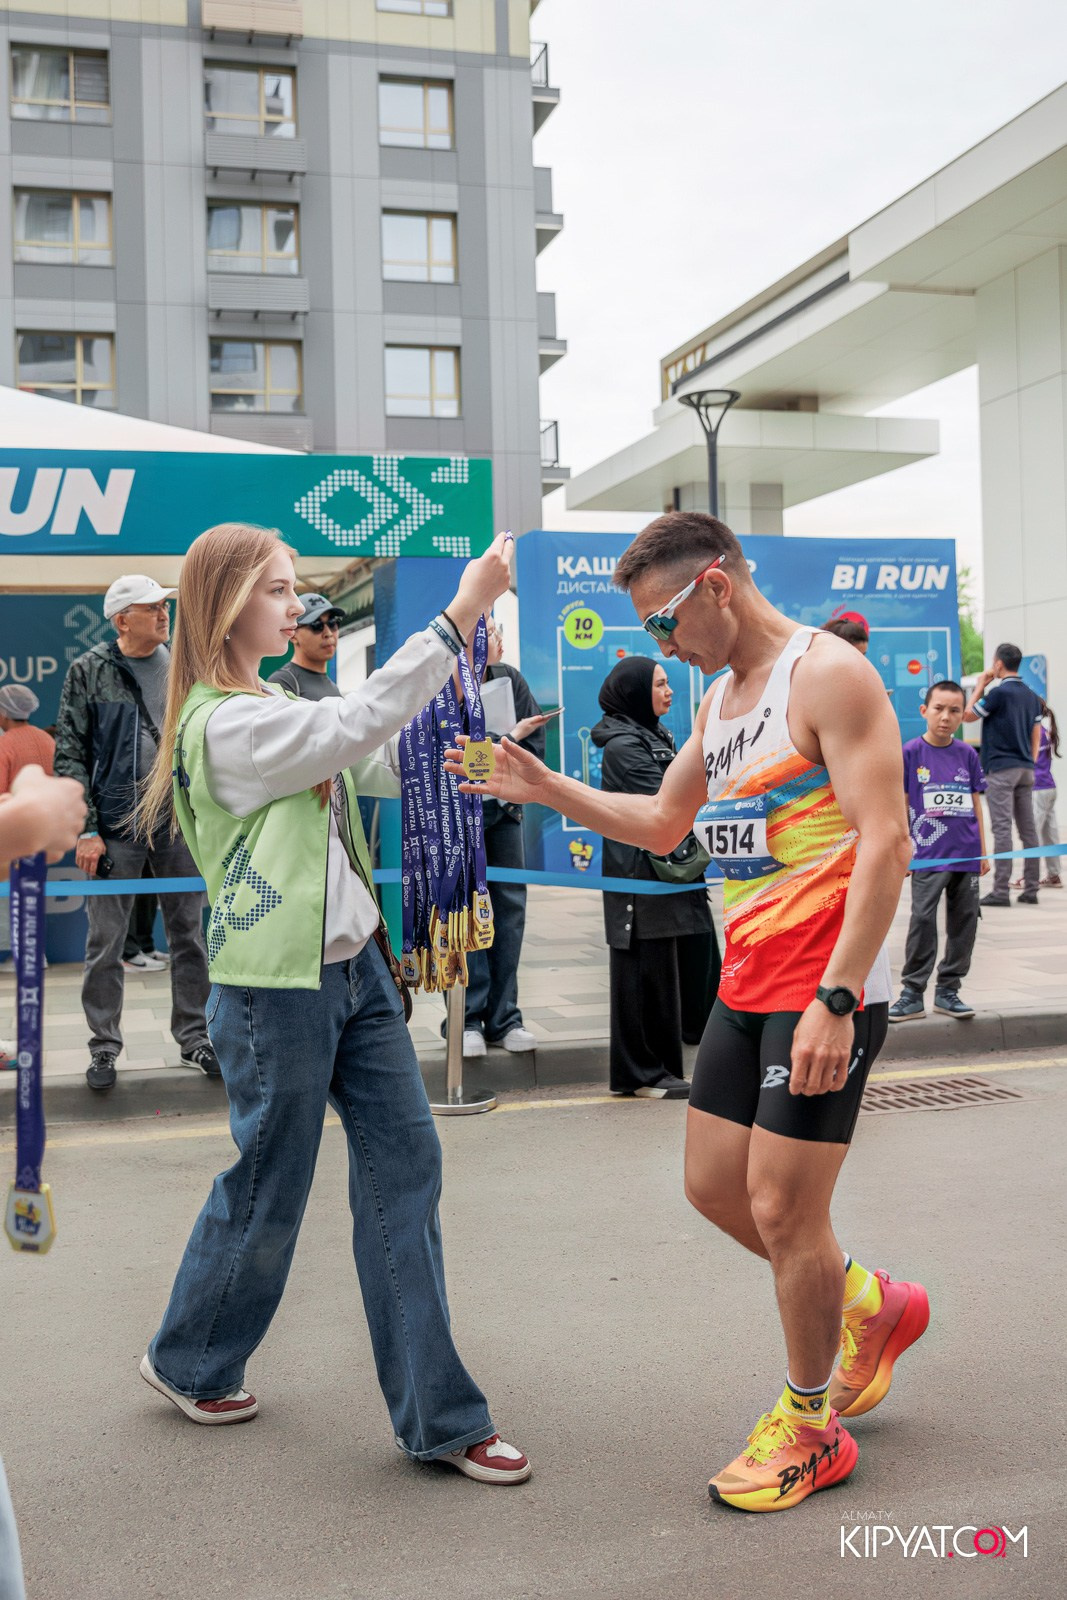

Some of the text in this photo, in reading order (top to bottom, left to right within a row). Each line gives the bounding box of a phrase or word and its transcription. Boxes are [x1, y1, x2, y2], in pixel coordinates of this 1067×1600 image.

[831, 565, 950, 590] BI RUN
[575, 618, 593, 631] 10
[405, 731, 413, 755] Dream
[423, 771, 433, 804] JULDYZAI
[934, 793, 963, 806] 034
[442, 805, 451, 847] ДОБРЫМ
[704, 823, 755, 855] 1514
